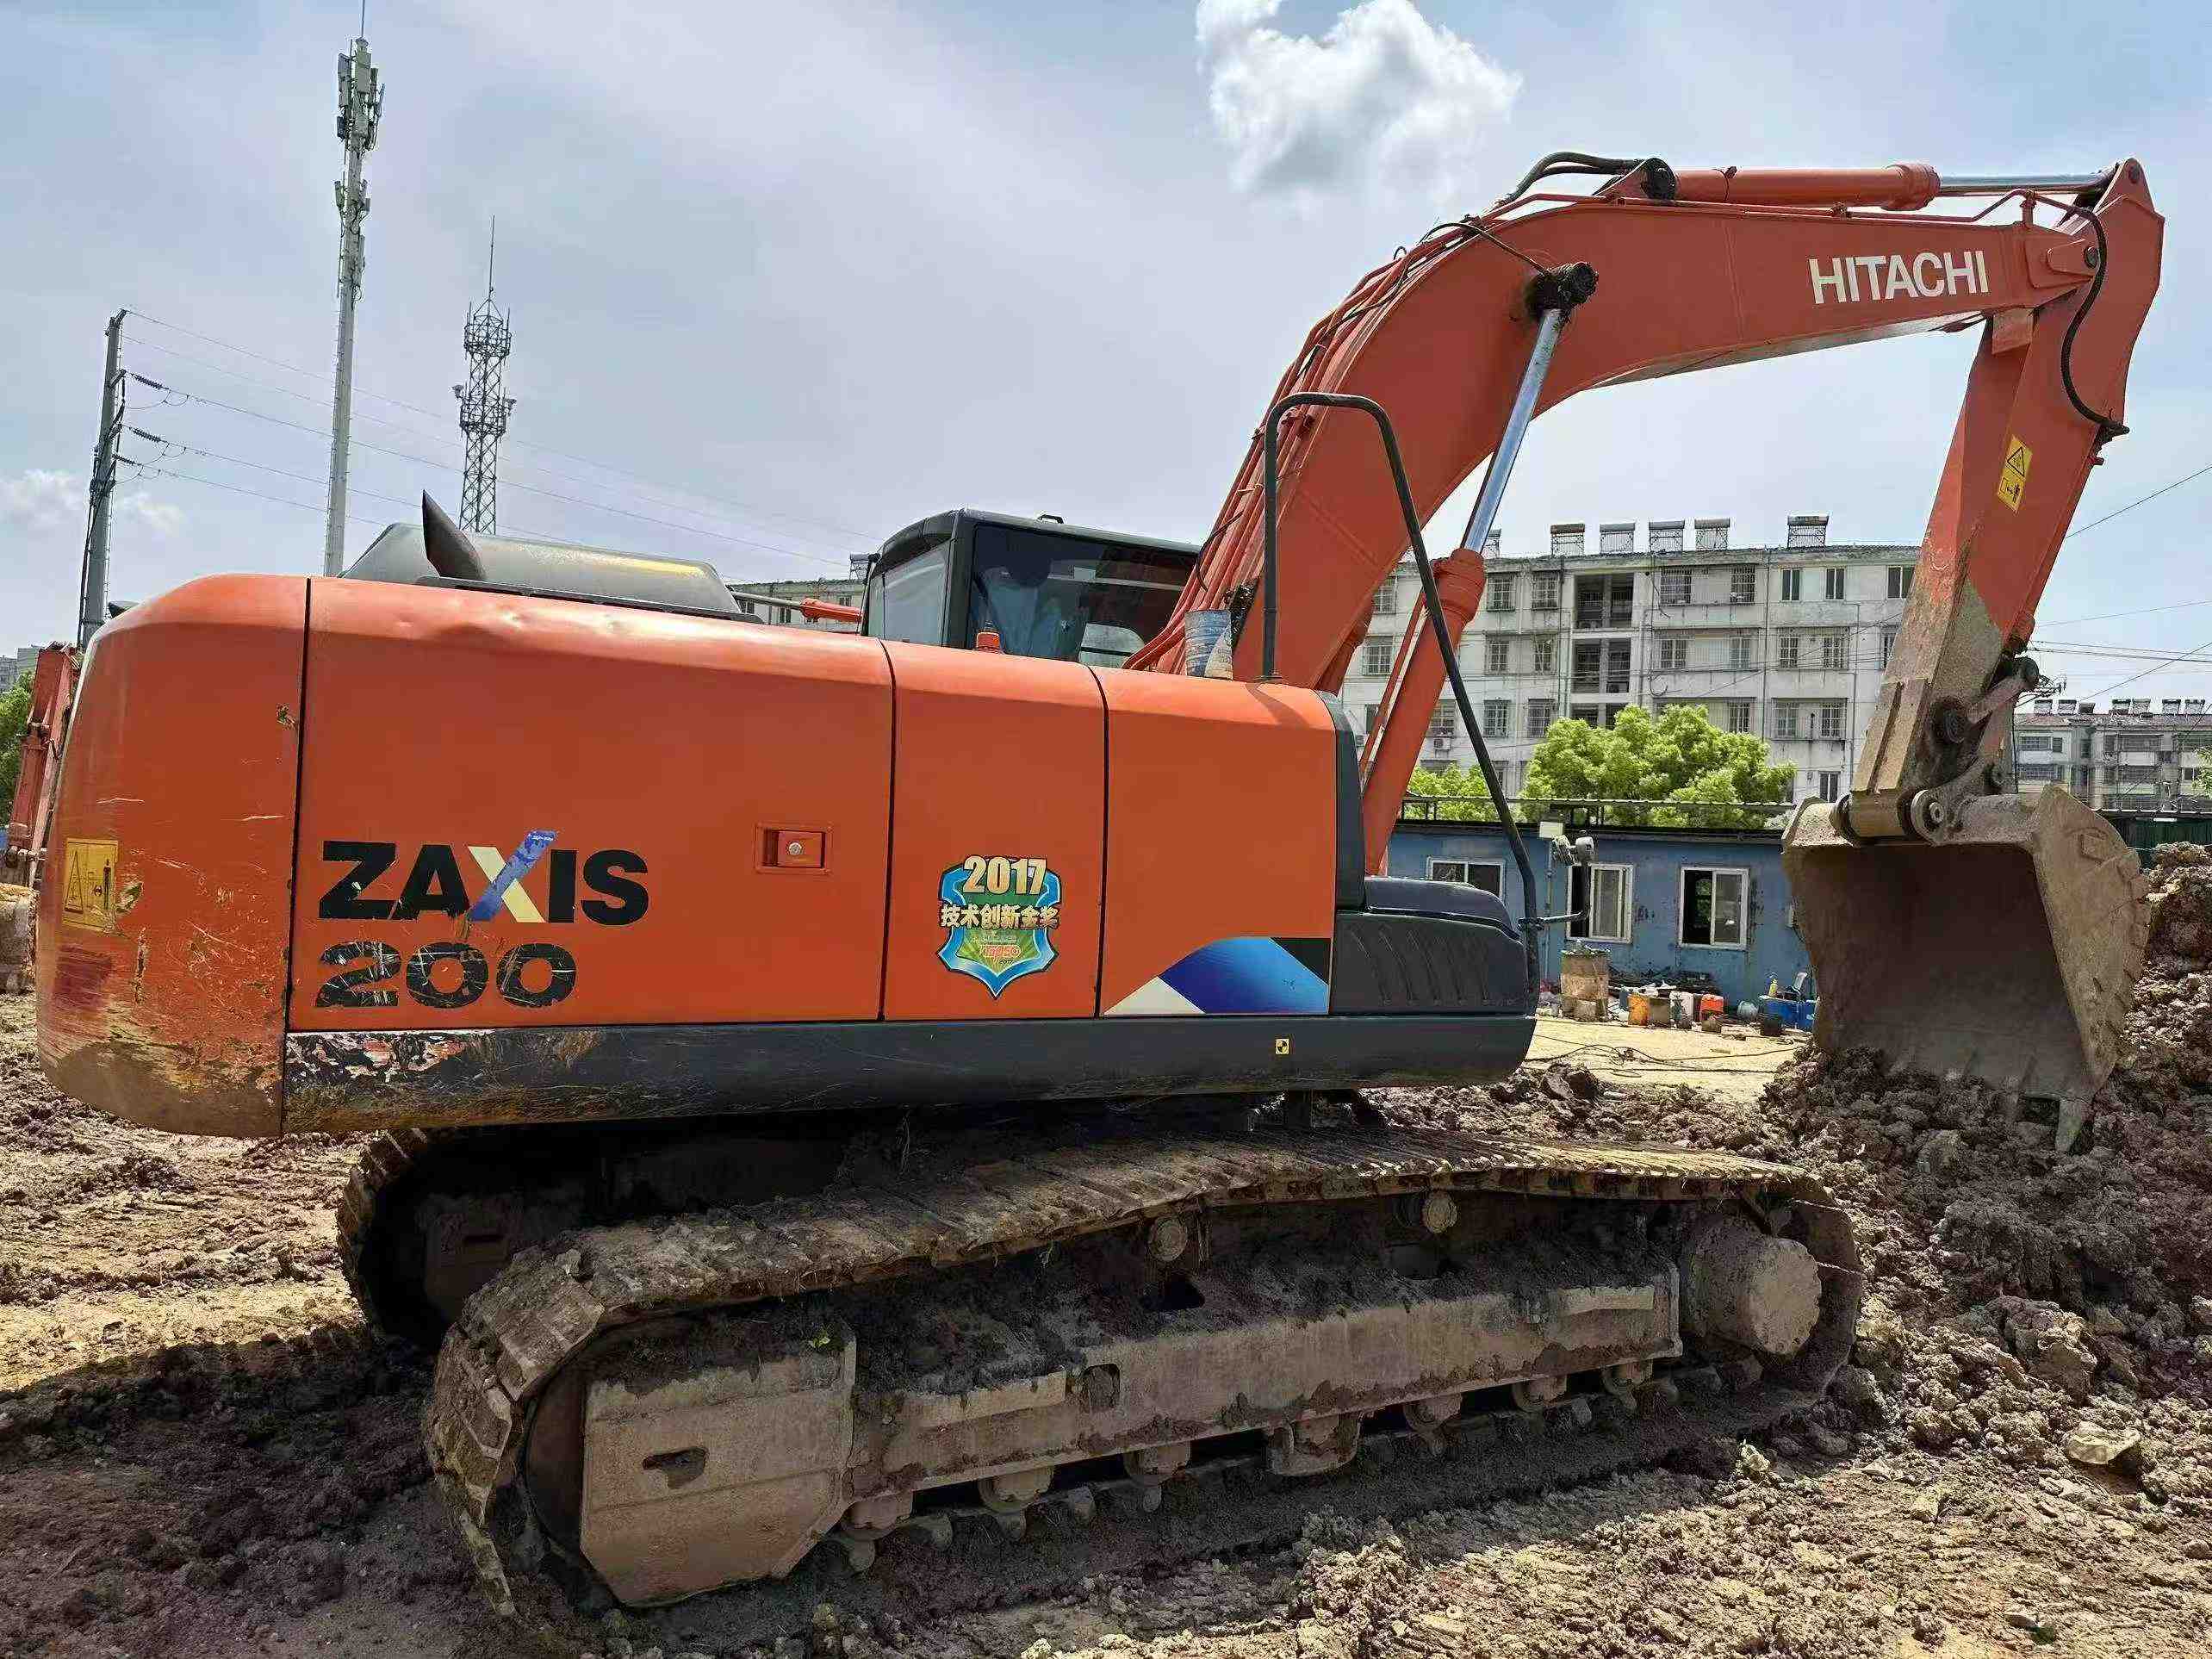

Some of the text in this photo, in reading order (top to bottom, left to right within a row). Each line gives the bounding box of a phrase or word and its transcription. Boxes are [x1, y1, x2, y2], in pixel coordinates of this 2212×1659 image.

[1809, 250, 1989, 304] HITACHI
[319, 830, 649, 925] ZAXIS
[963, 855, 1047, 895] 2017
[941, 904, 1059, 929] 技术创新金奖
[315, 942, 577, 1008] 200
